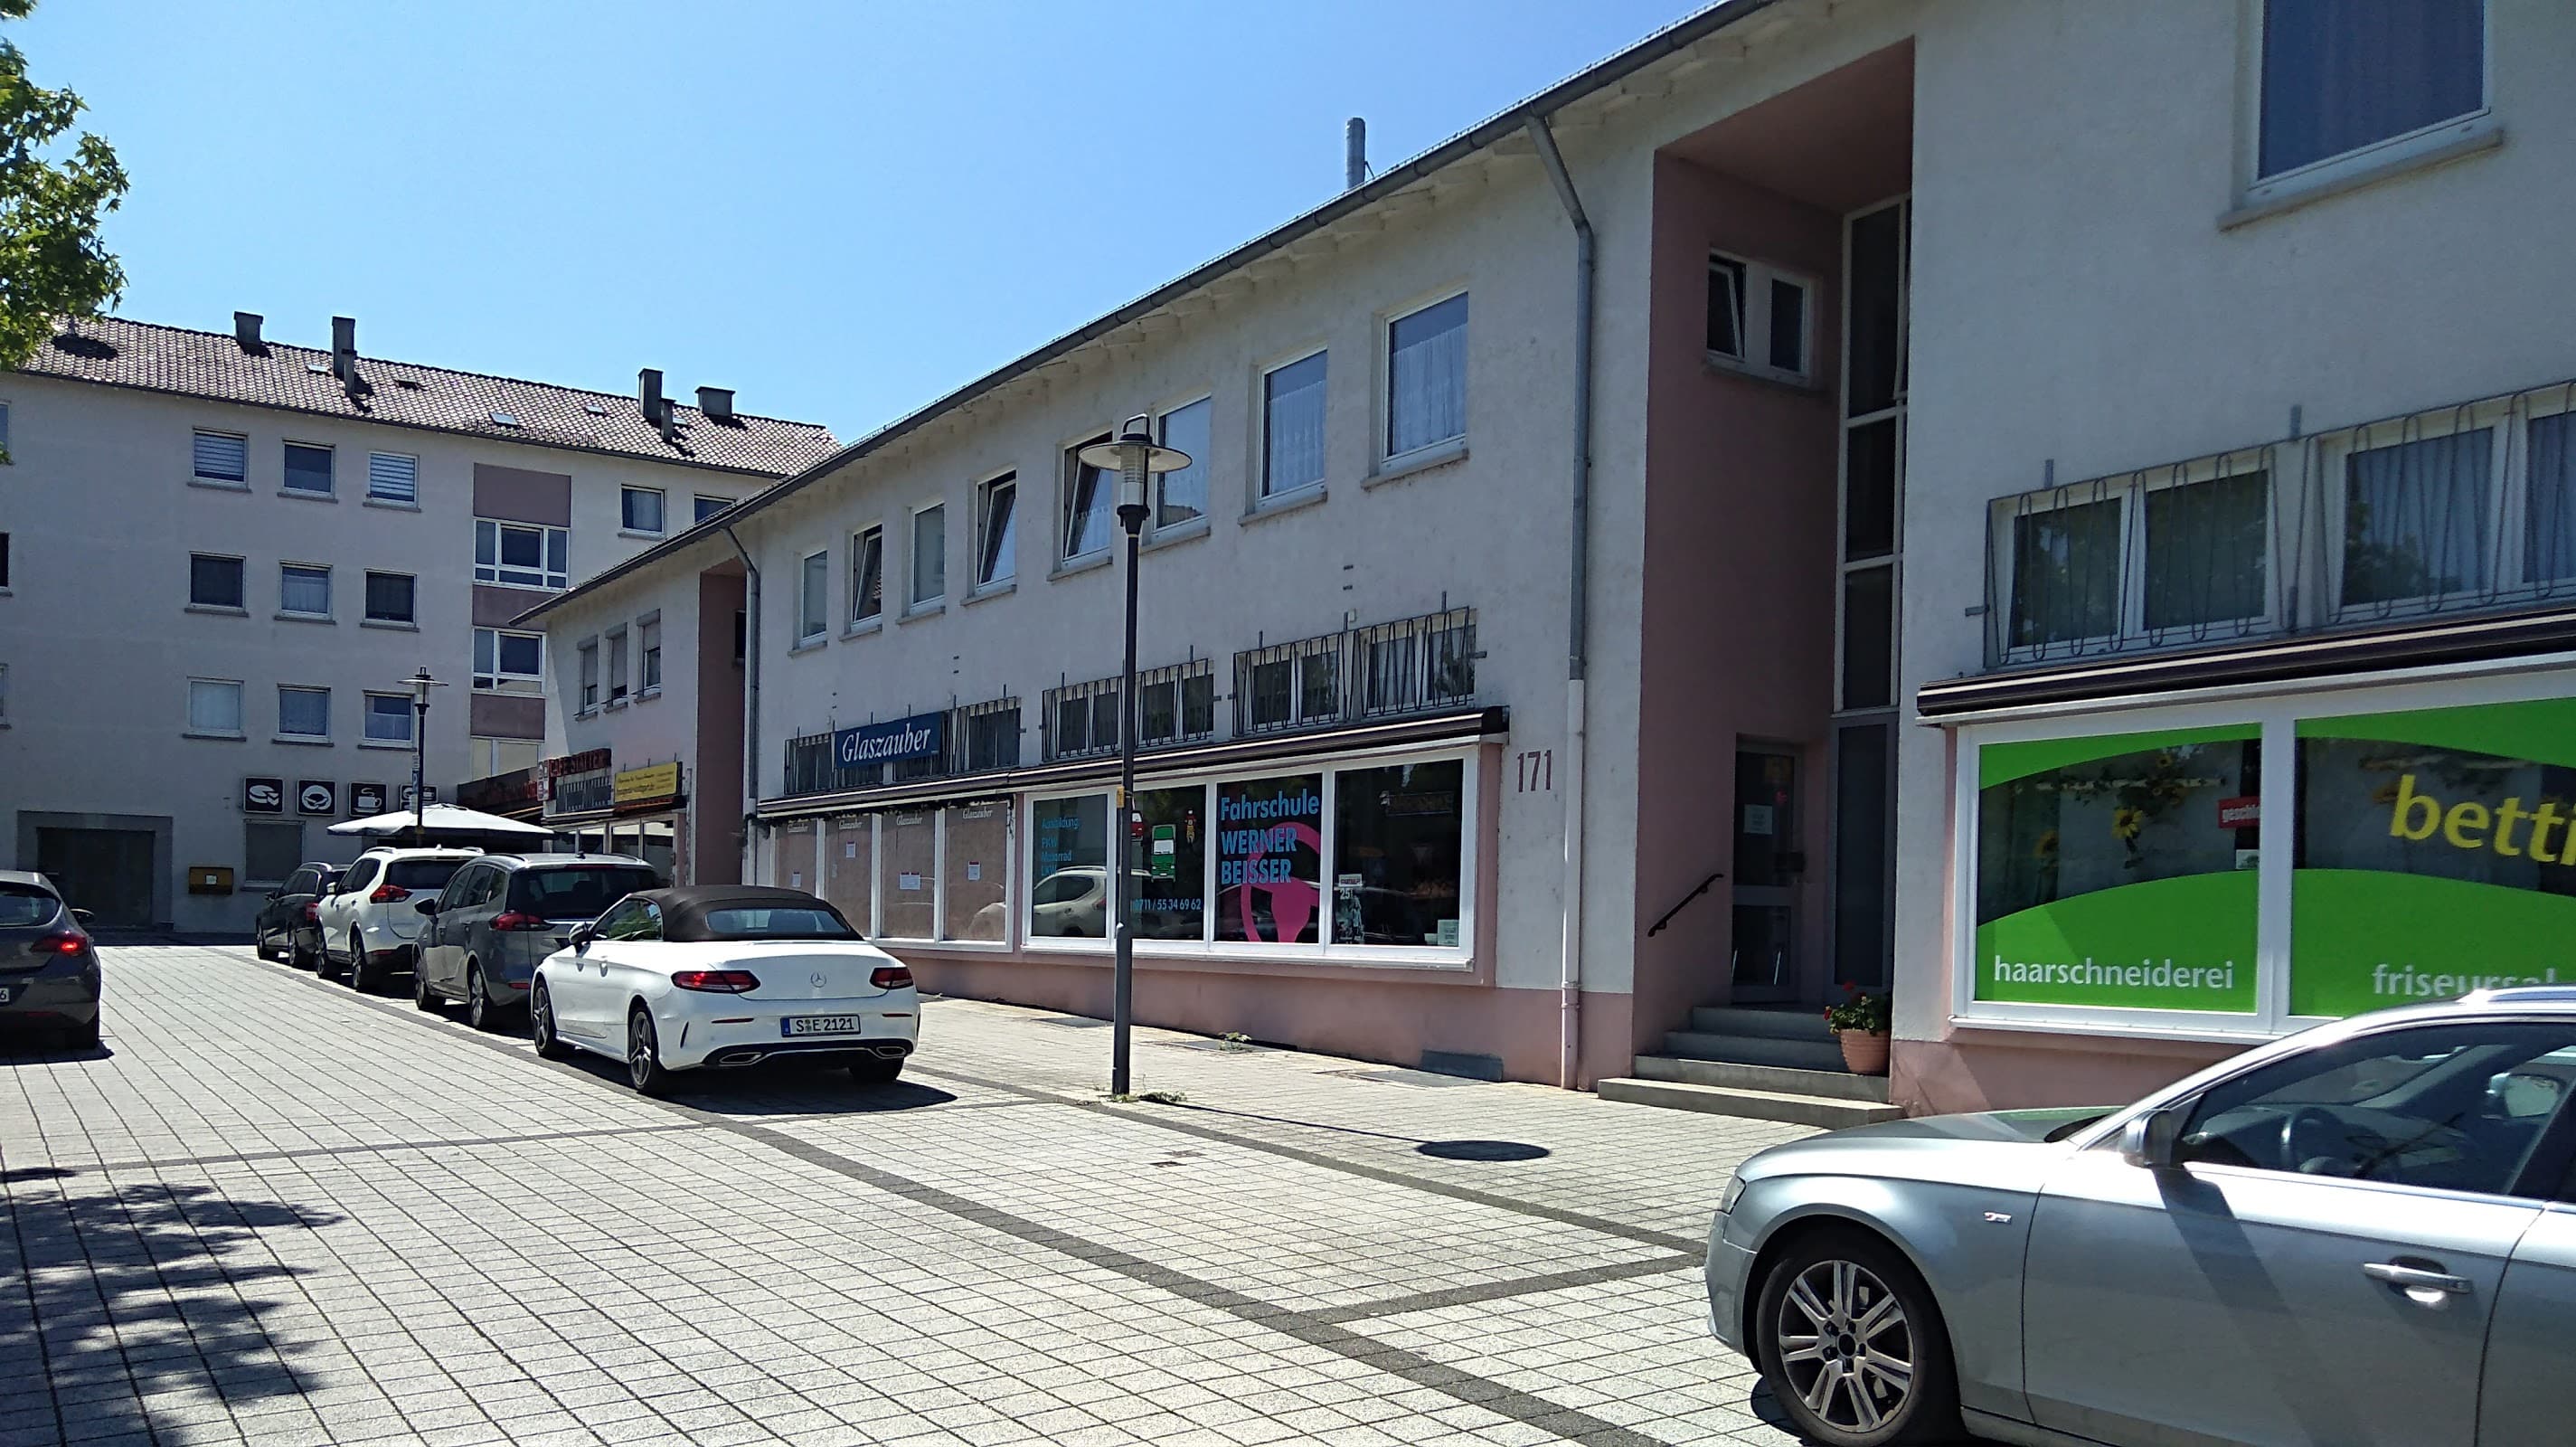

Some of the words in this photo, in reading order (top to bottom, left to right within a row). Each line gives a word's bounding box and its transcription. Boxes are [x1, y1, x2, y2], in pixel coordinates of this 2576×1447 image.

[842, 723, 930, 761] Glaszauber
[1517, 750, 1552, 792] 171
[1221, 788, 1319, 820] Fahrschule
[1221, 827, 1297, 855] WERNER
[1221, 858, 1291, 884] BEISSER
[1995, 955, 2233, 988] haarschneiderei
[796, 1019, 805, 1032] S
[813, 1018, 821, 1031] E
[824, 1017, 854, 1031] 2121
